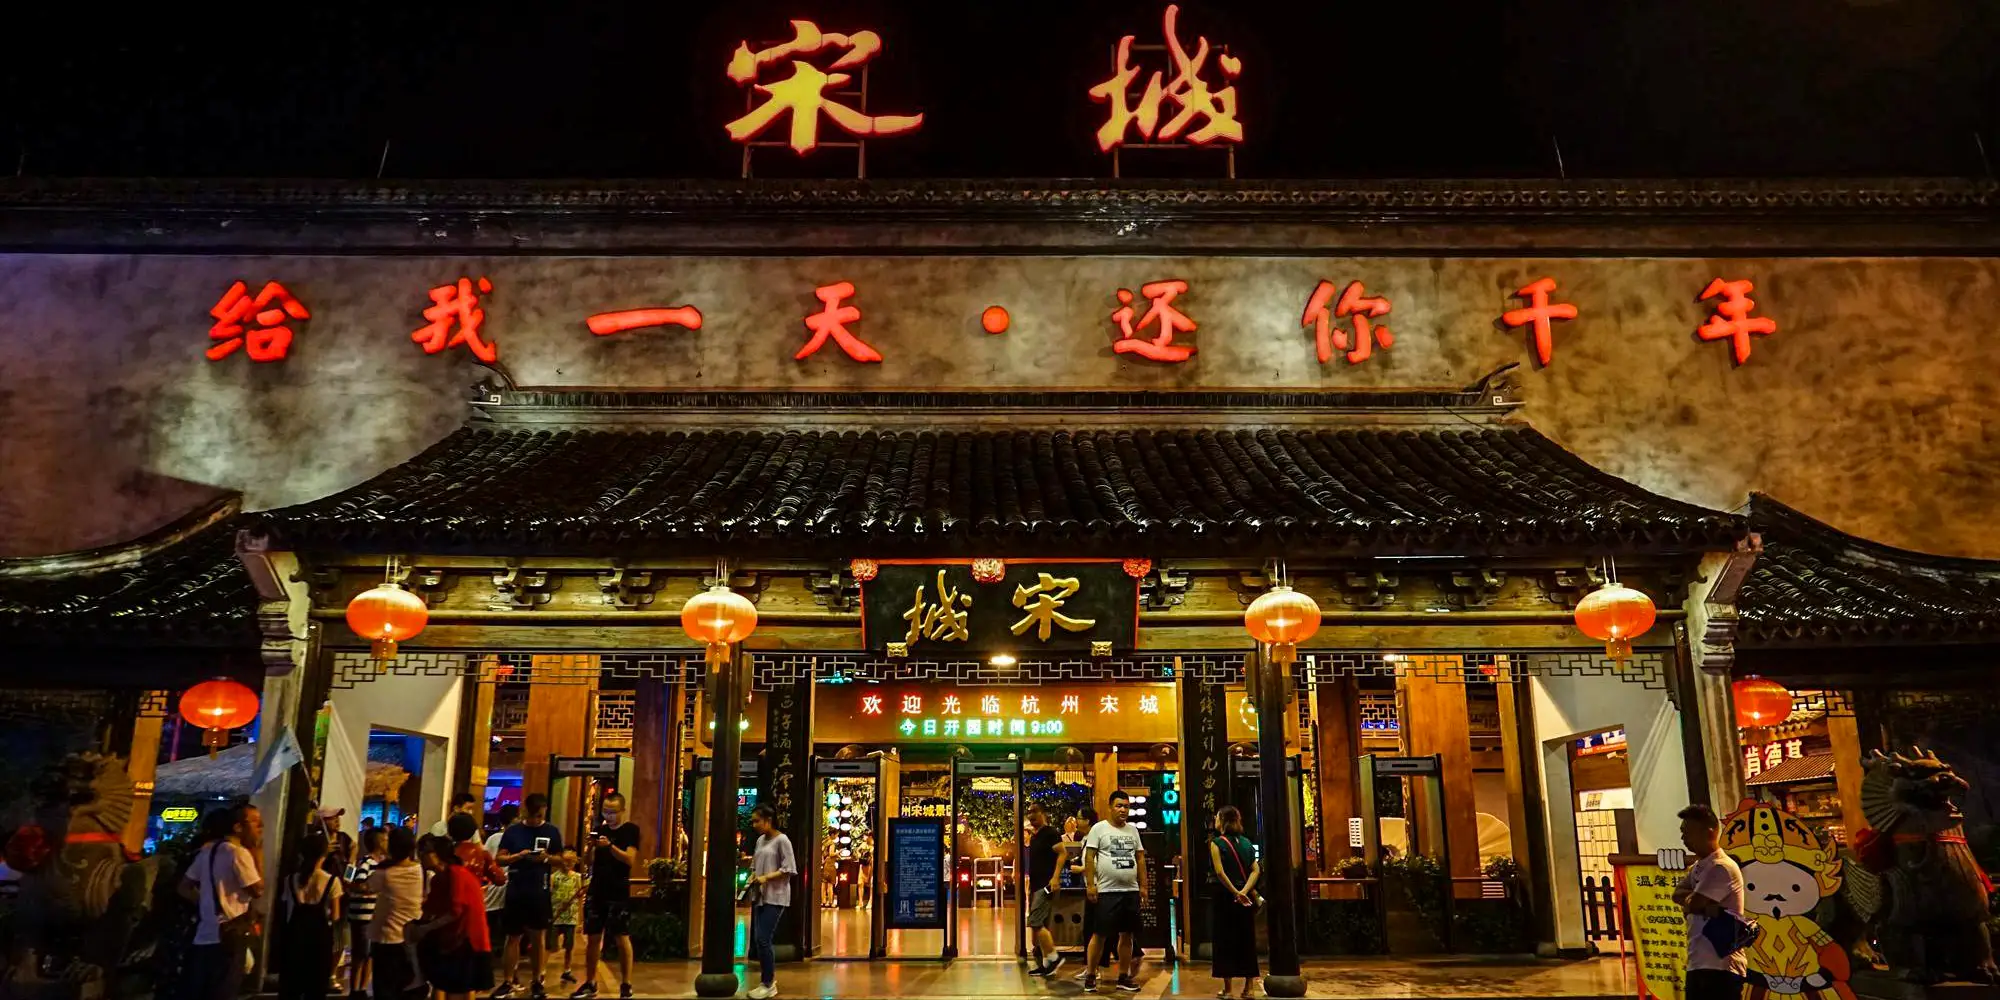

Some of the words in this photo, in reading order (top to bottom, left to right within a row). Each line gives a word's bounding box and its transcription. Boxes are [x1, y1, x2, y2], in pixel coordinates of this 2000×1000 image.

[725, 4, 1243, 155] 宋城
[206, 276, 1776, 366] 给我一天·还你千年
[862, 694, 1159, 715] 欢迎光临杭州宋城
